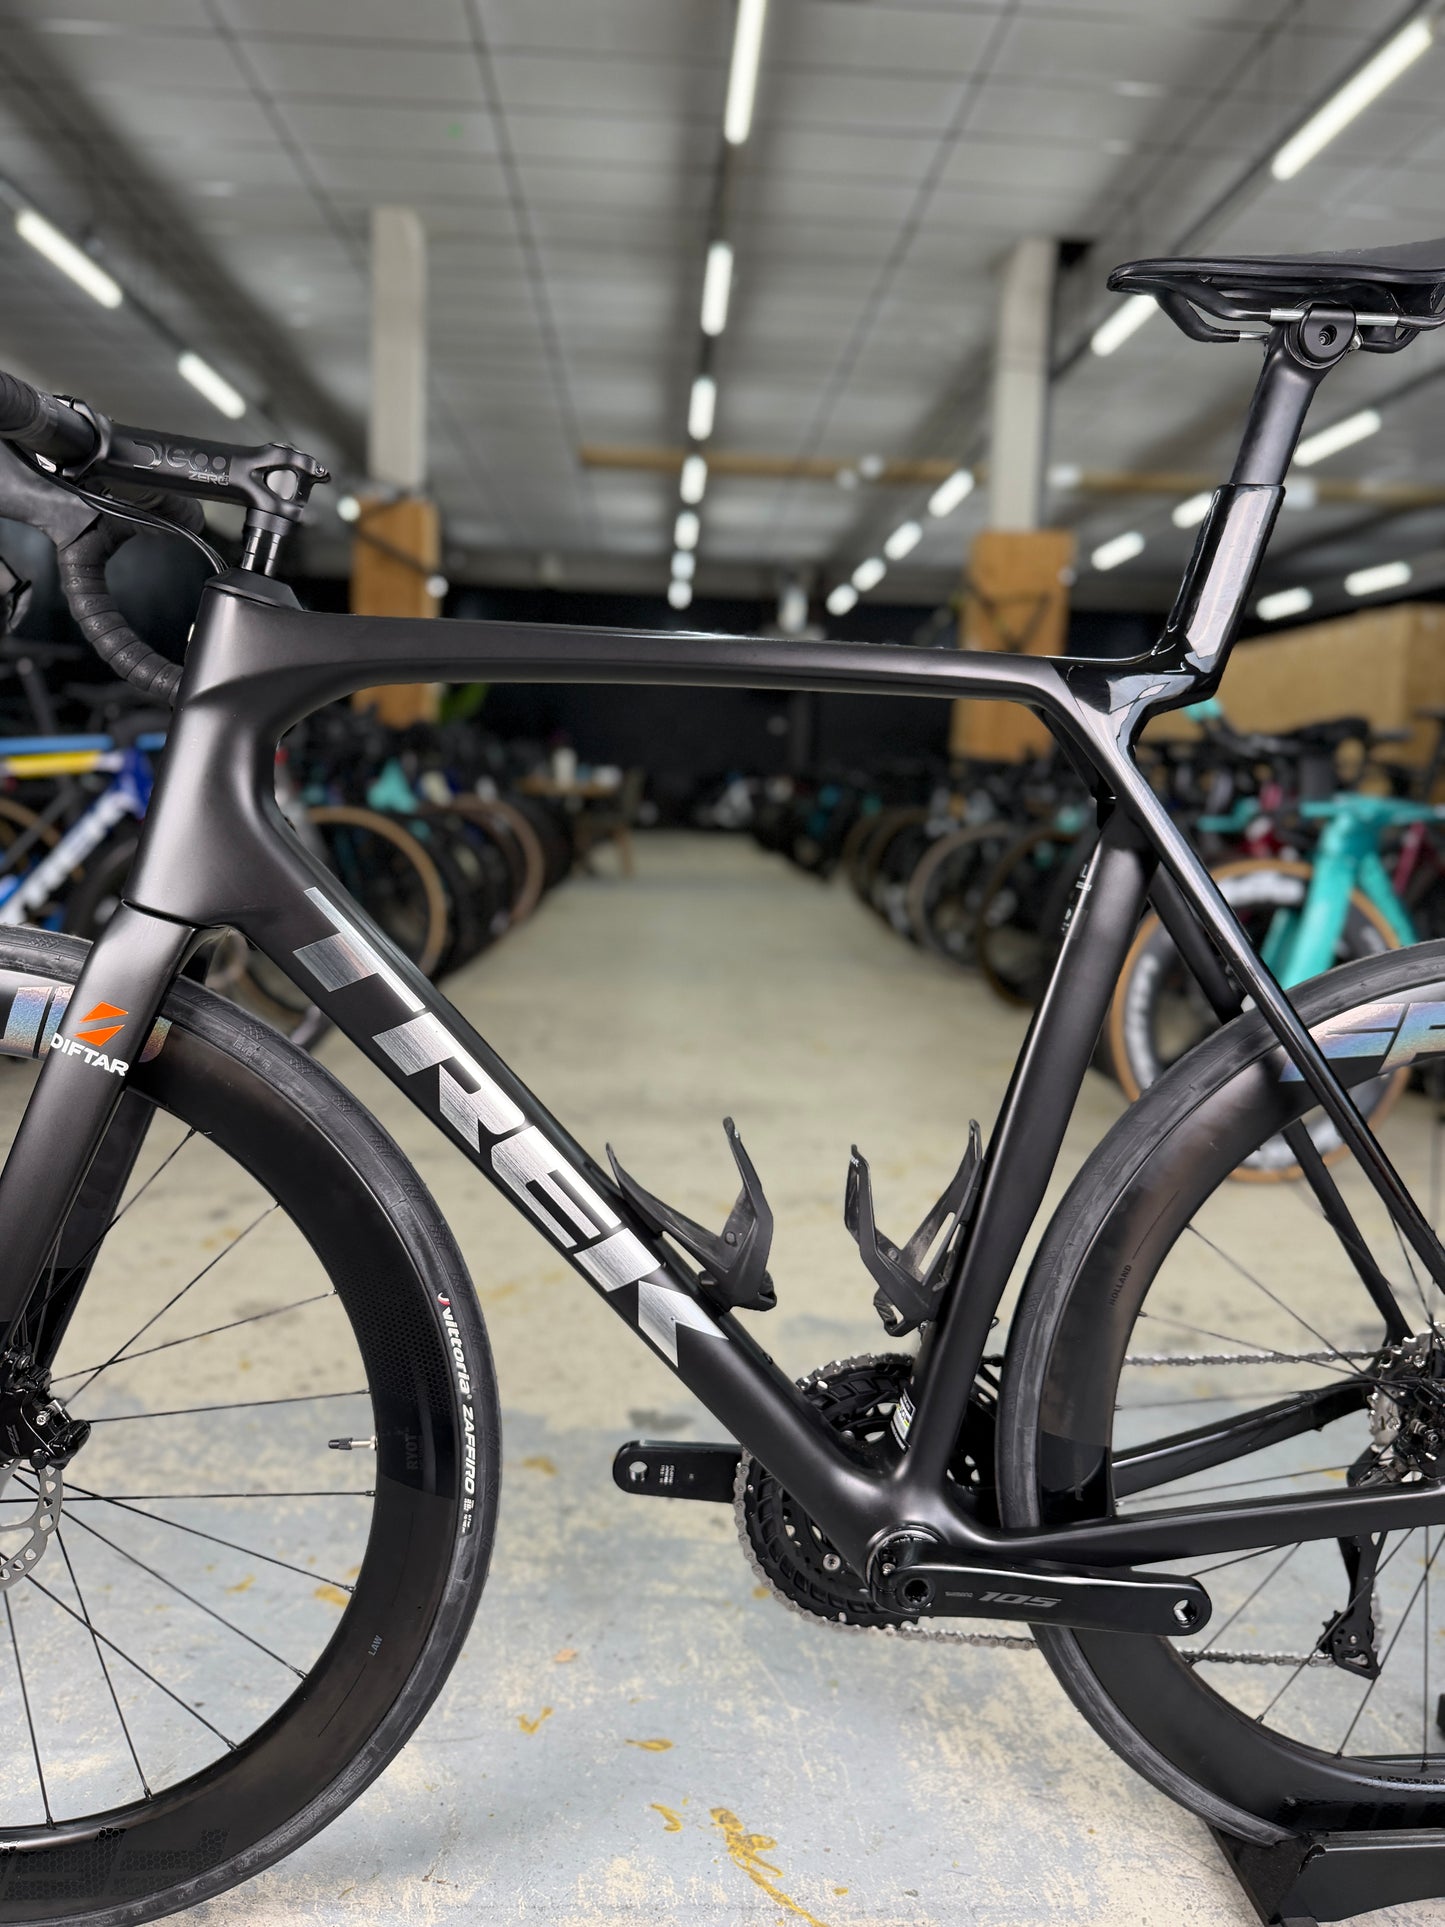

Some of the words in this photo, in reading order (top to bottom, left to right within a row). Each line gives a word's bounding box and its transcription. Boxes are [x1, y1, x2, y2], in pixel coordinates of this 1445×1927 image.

[50, 1032, 130, 1077] DIFTAR
[293, 886, 729, 1368] TREK
[462, 1403, 476, 1495] ZAFFIRO
[978, 1591, 1062, 1608] 105
[367, 1634, 383, 1656] LAW
